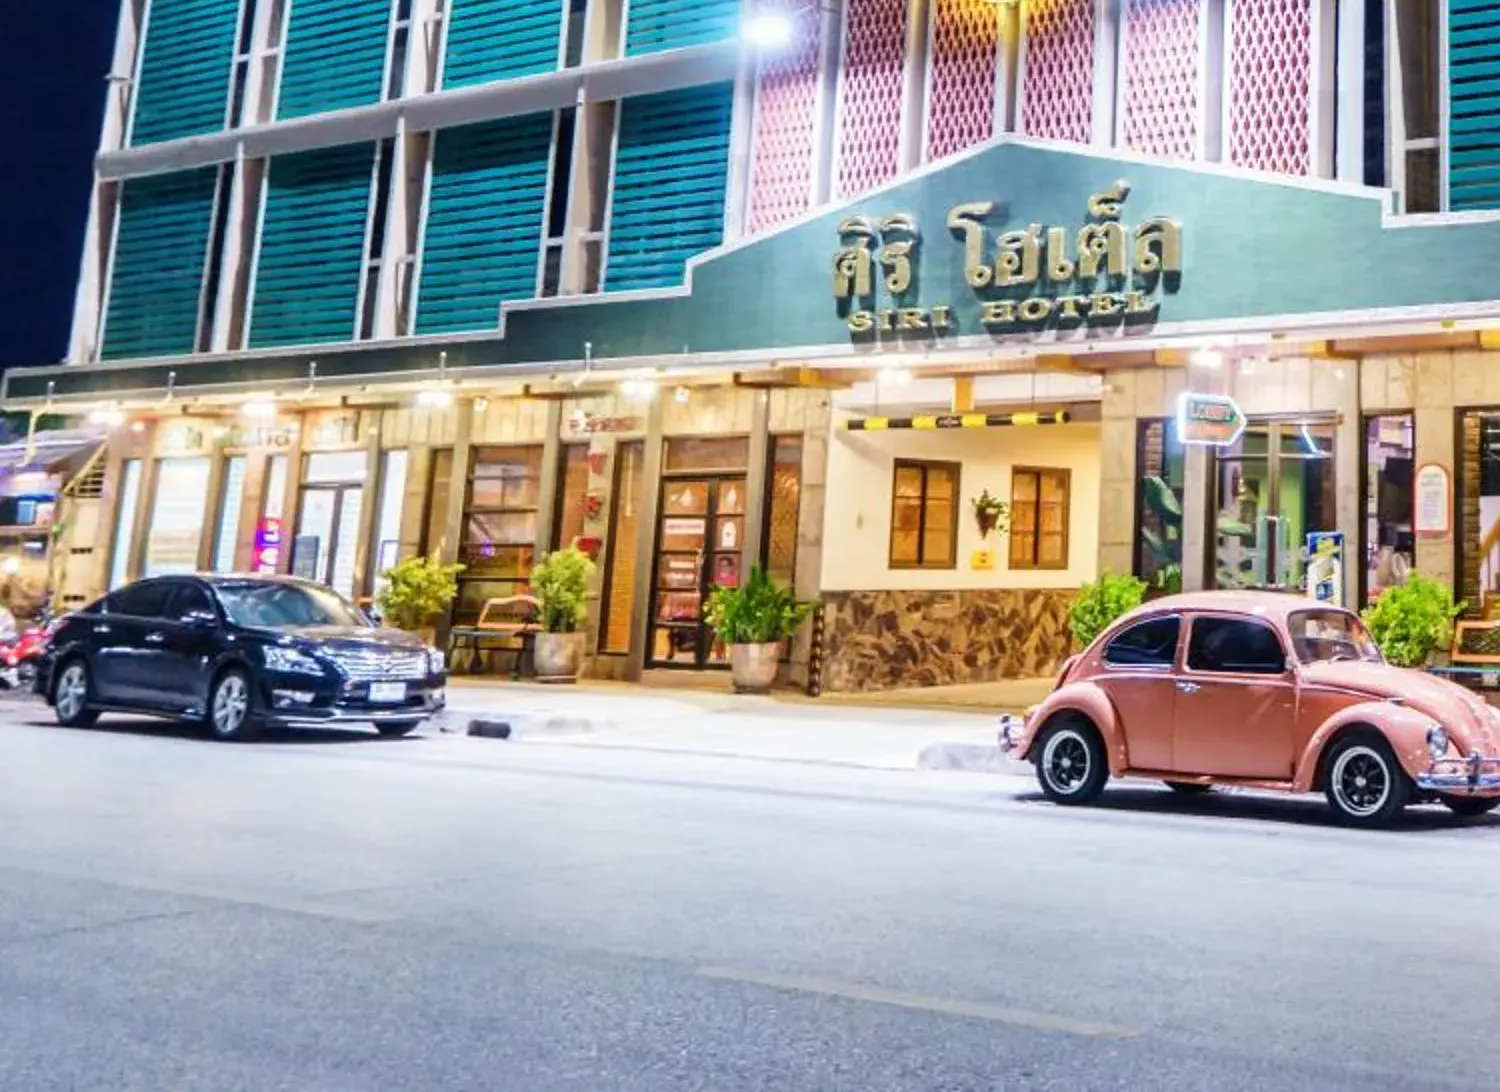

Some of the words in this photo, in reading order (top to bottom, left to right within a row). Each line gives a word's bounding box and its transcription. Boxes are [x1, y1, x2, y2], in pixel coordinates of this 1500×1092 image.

[832, 214, 918, 298] ศิริ
[948, 179, 1183, 288] โฮเต็ล
[847, 306, 950, 331] SIRI
[980, 291, 1157, 323] HOTEL
